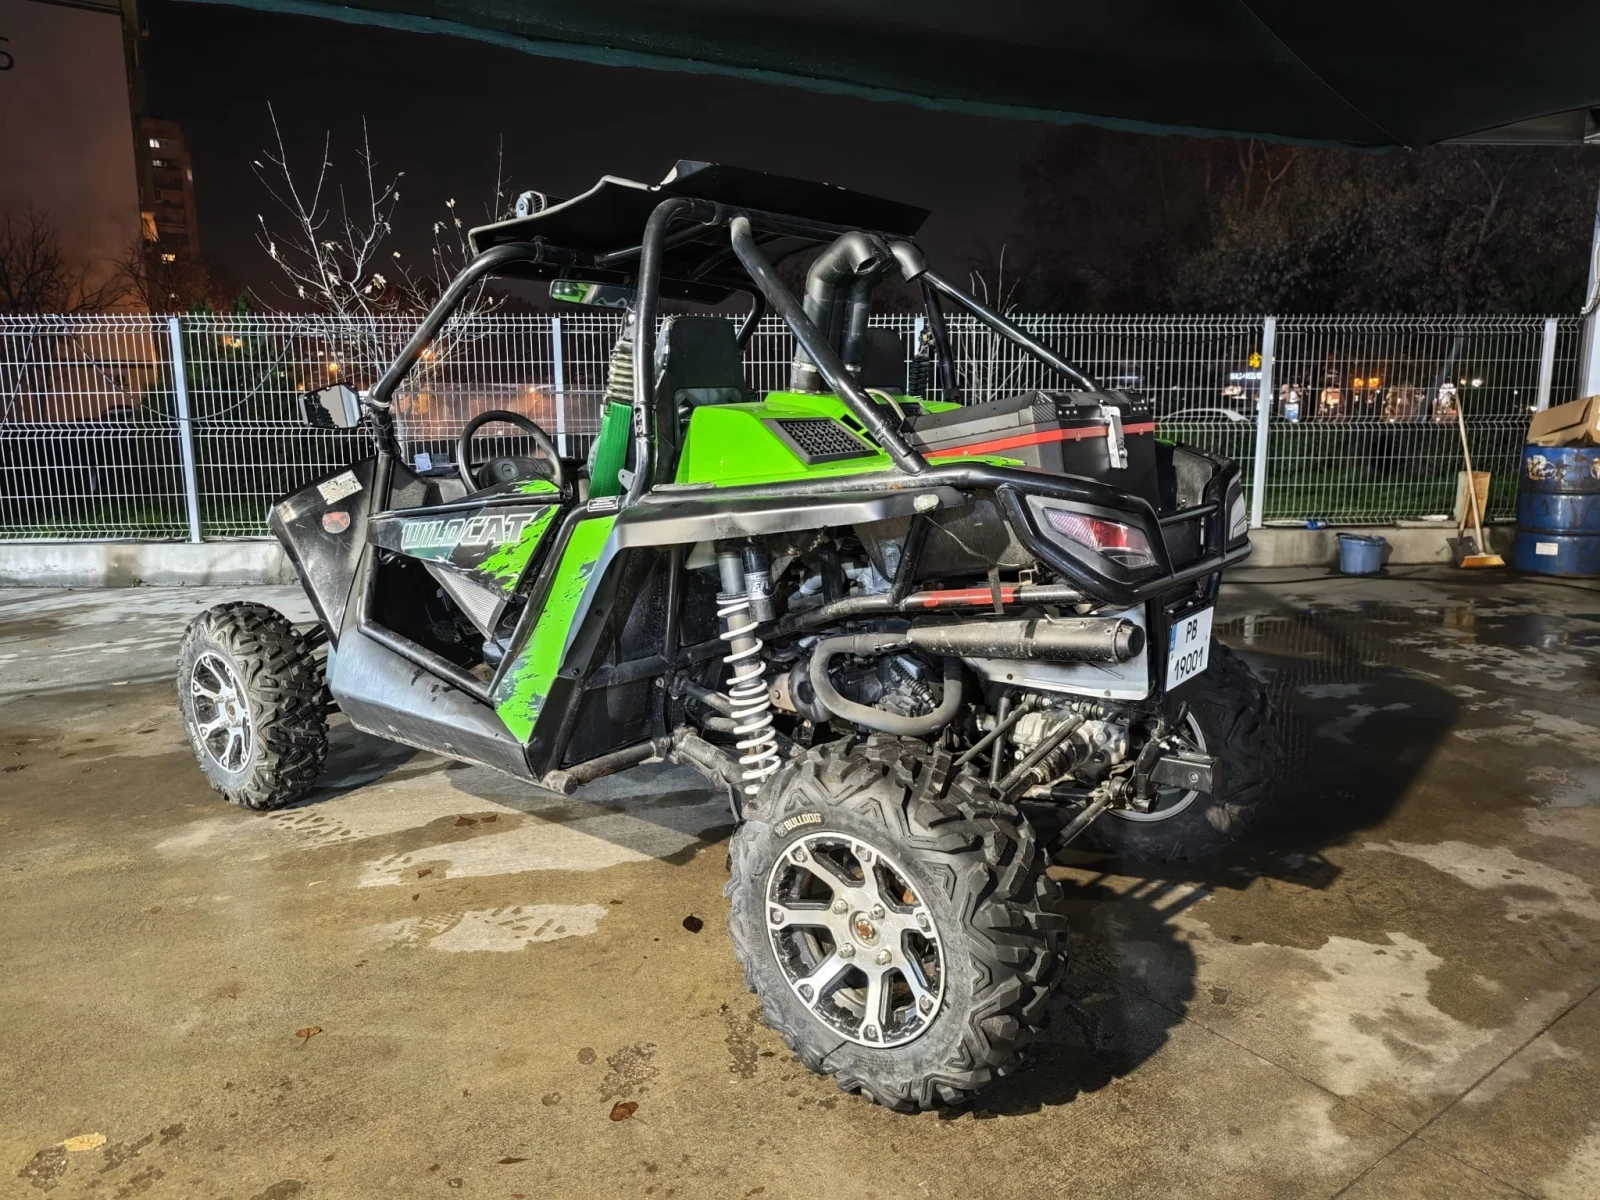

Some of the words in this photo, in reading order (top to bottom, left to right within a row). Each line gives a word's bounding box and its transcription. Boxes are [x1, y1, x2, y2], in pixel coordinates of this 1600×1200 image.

[401, 511, 538, 551] WILDCAT
[1186, 619, 1198, 644] PB
[1174, 646, 1204, 681] 19001
[783, 812, 822, 831] BULLDOG
